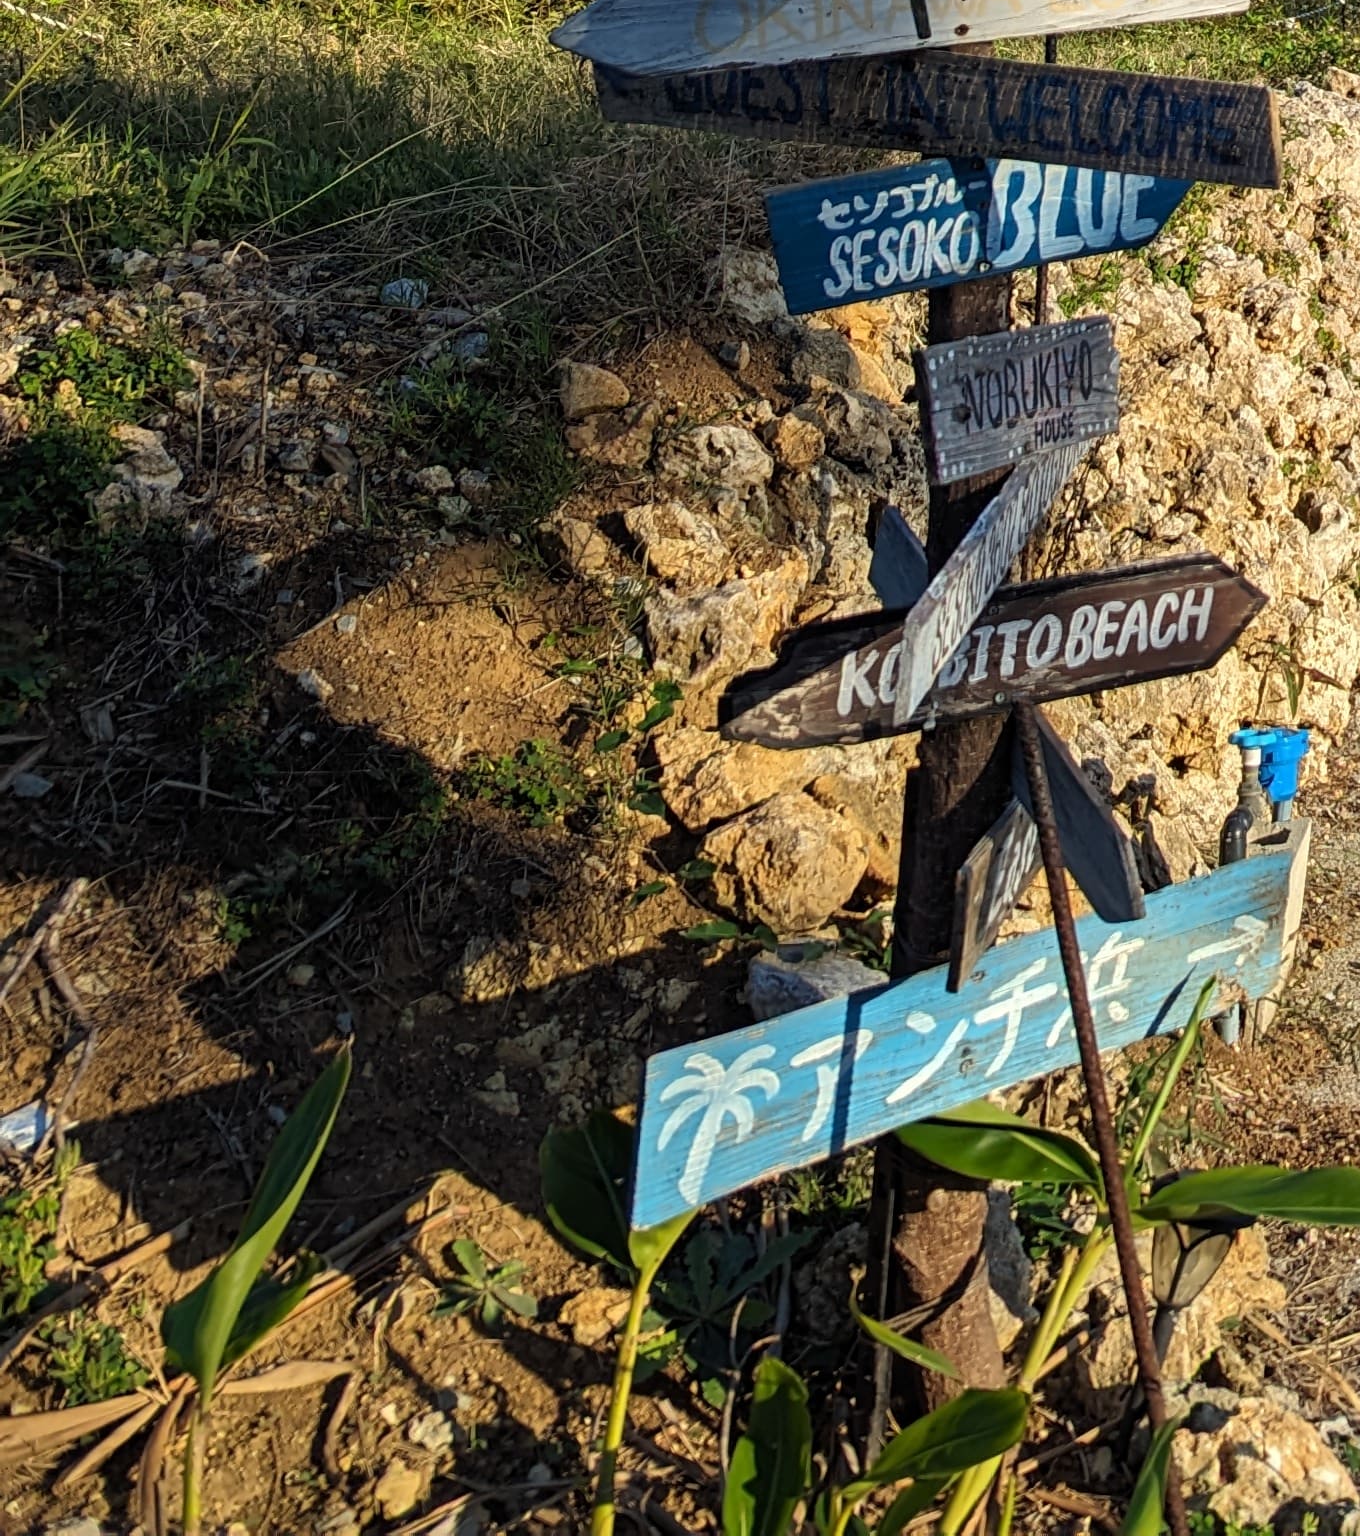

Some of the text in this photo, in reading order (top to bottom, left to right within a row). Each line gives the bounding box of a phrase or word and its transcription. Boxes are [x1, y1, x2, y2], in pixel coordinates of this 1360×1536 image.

[983, 67, 1243, 165] WELCOME
[823, 159, 1158, 299] SESOKO BLUE
[961, 340, 1093, 434] NOBUKIYO
[1034, 410, 1075, 447] HOUSE
